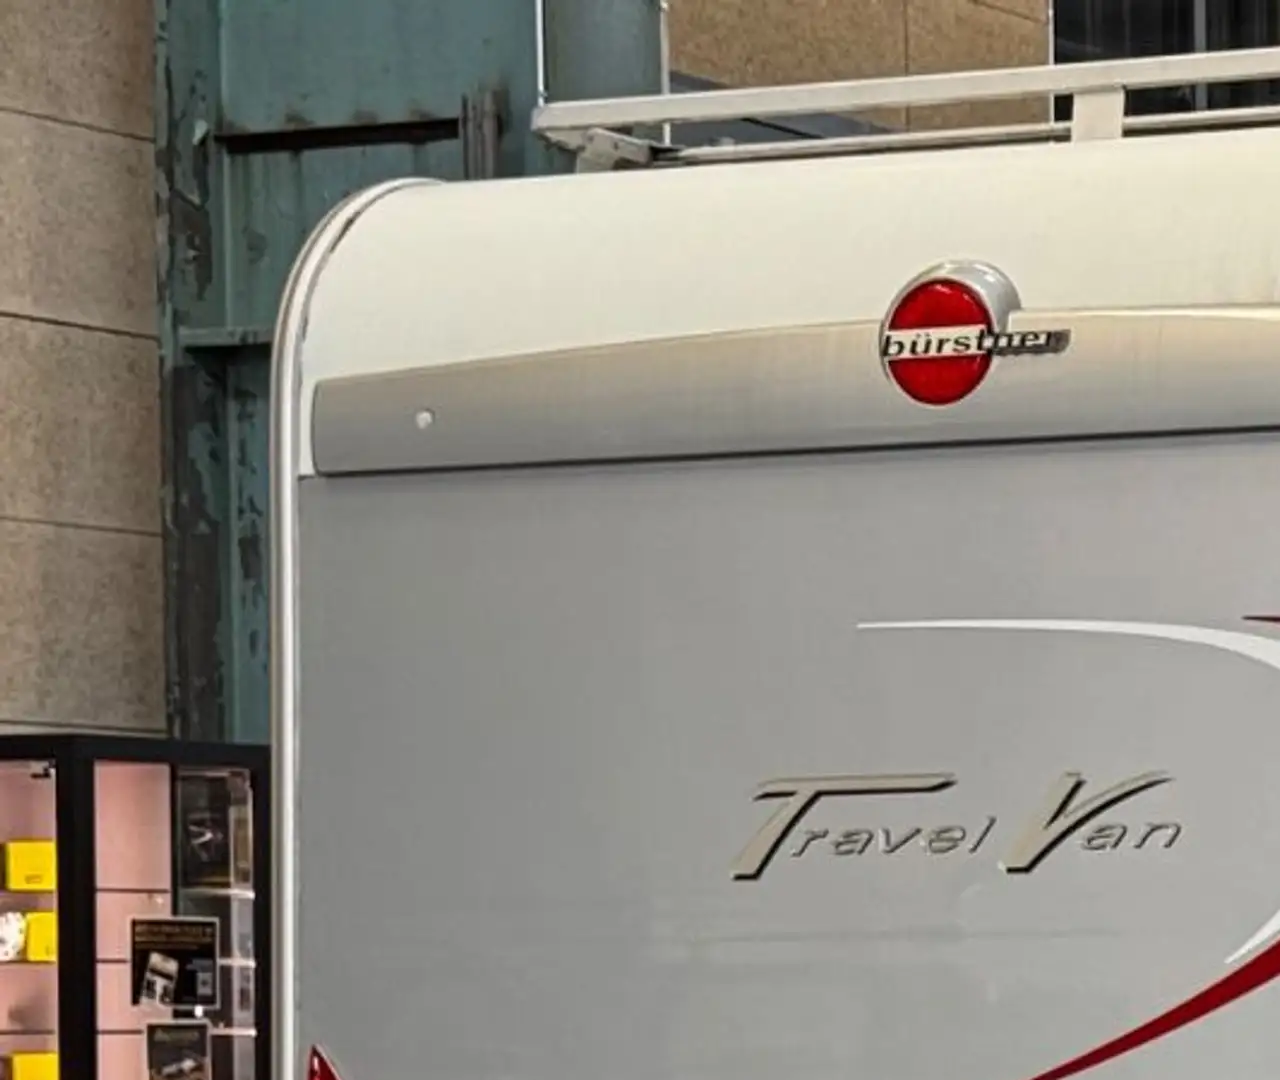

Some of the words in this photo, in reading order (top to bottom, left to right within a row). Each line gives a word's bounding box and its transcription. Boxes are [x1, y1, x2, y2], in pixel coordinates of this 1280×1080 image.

[882, 329, 1065, 358] bürstner
[732, 772, 997, 881] Travel
[1004, 769, 1184, 874] Van
